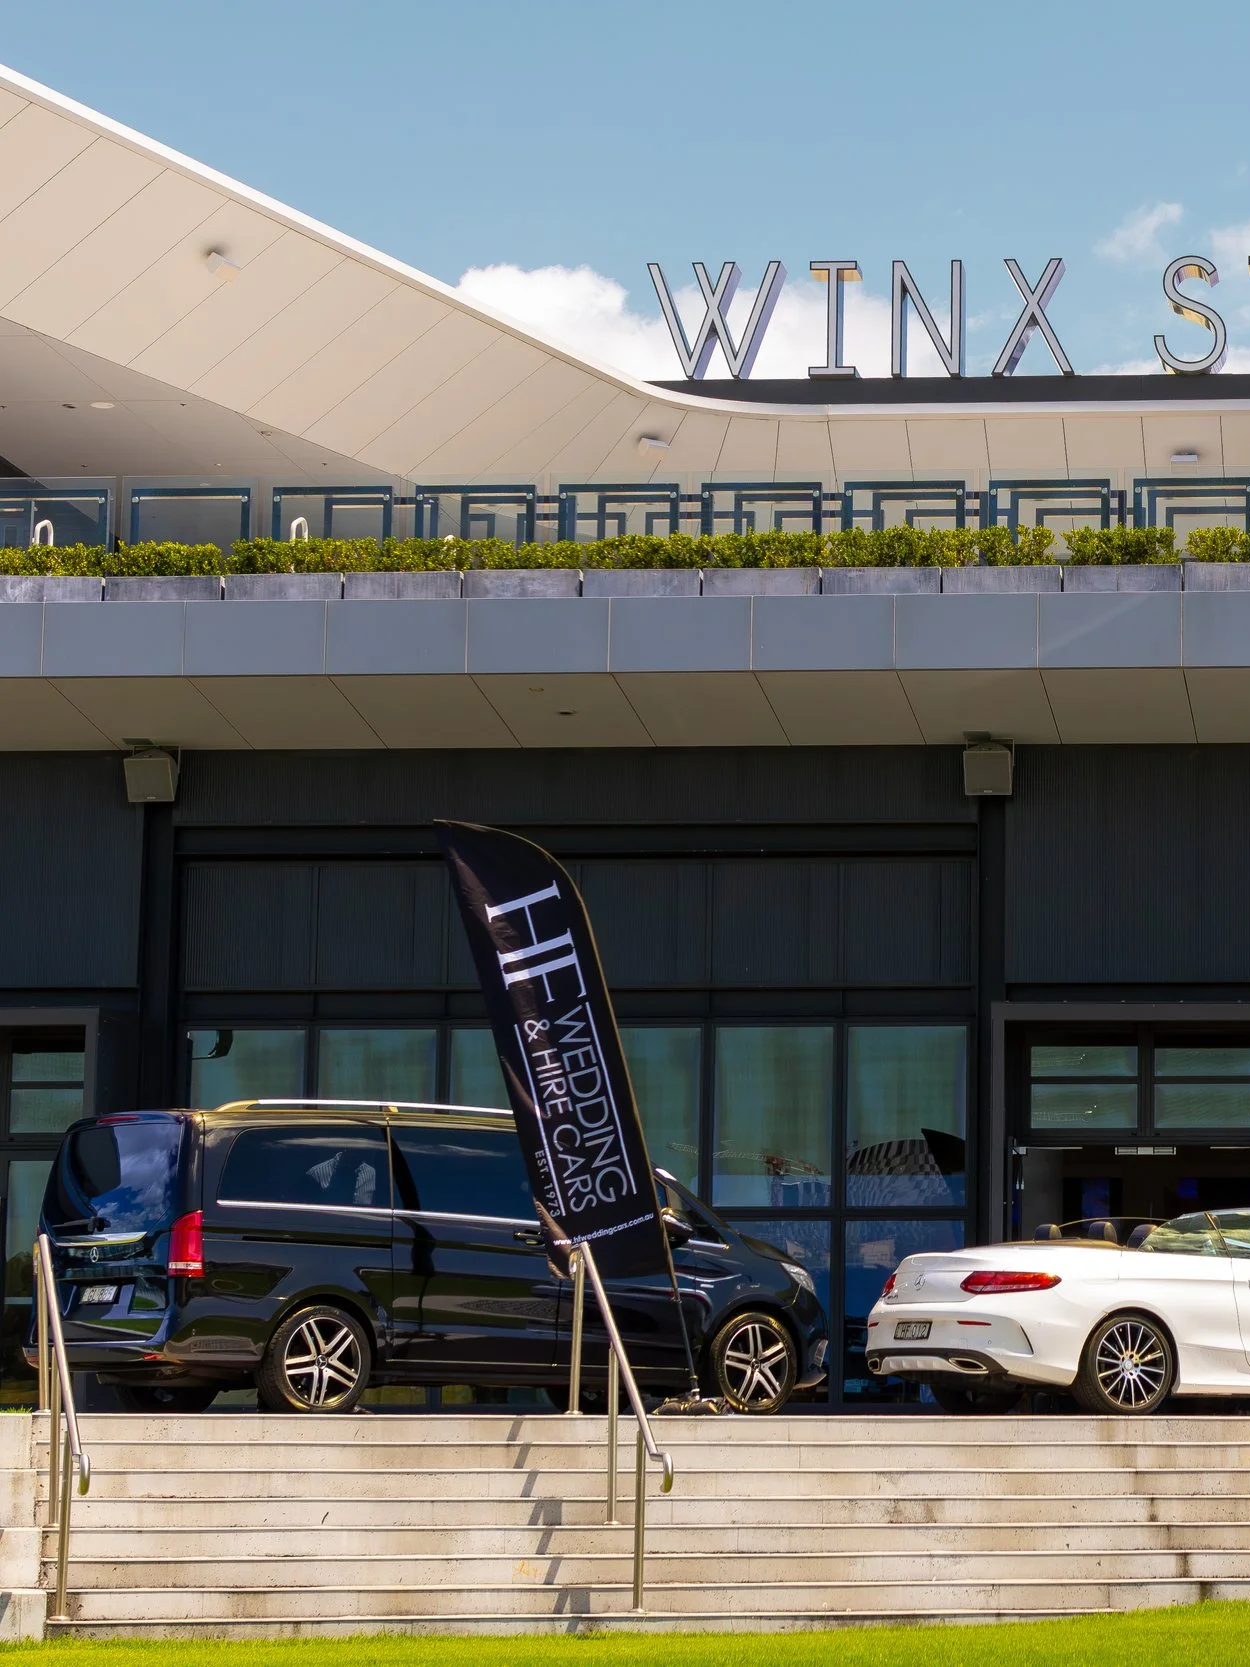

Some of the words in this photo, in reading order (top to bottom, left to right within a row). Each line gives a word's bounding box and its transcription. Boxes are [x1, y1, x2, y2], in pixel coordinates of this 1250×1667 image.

[647, 257, 1075, 381] WINX
[485, 880, 588, 1003] HF
[523, 1018, 550, 1043] &
[531, 1047, 574, 1119] HIRE
[554, 1004, 628, 1203] WEDDING
[534, 1149, 550, 1179] EST.
[543, 1183, 561, 1218] 1973
[552, 1123, 597, 1213] CARS
